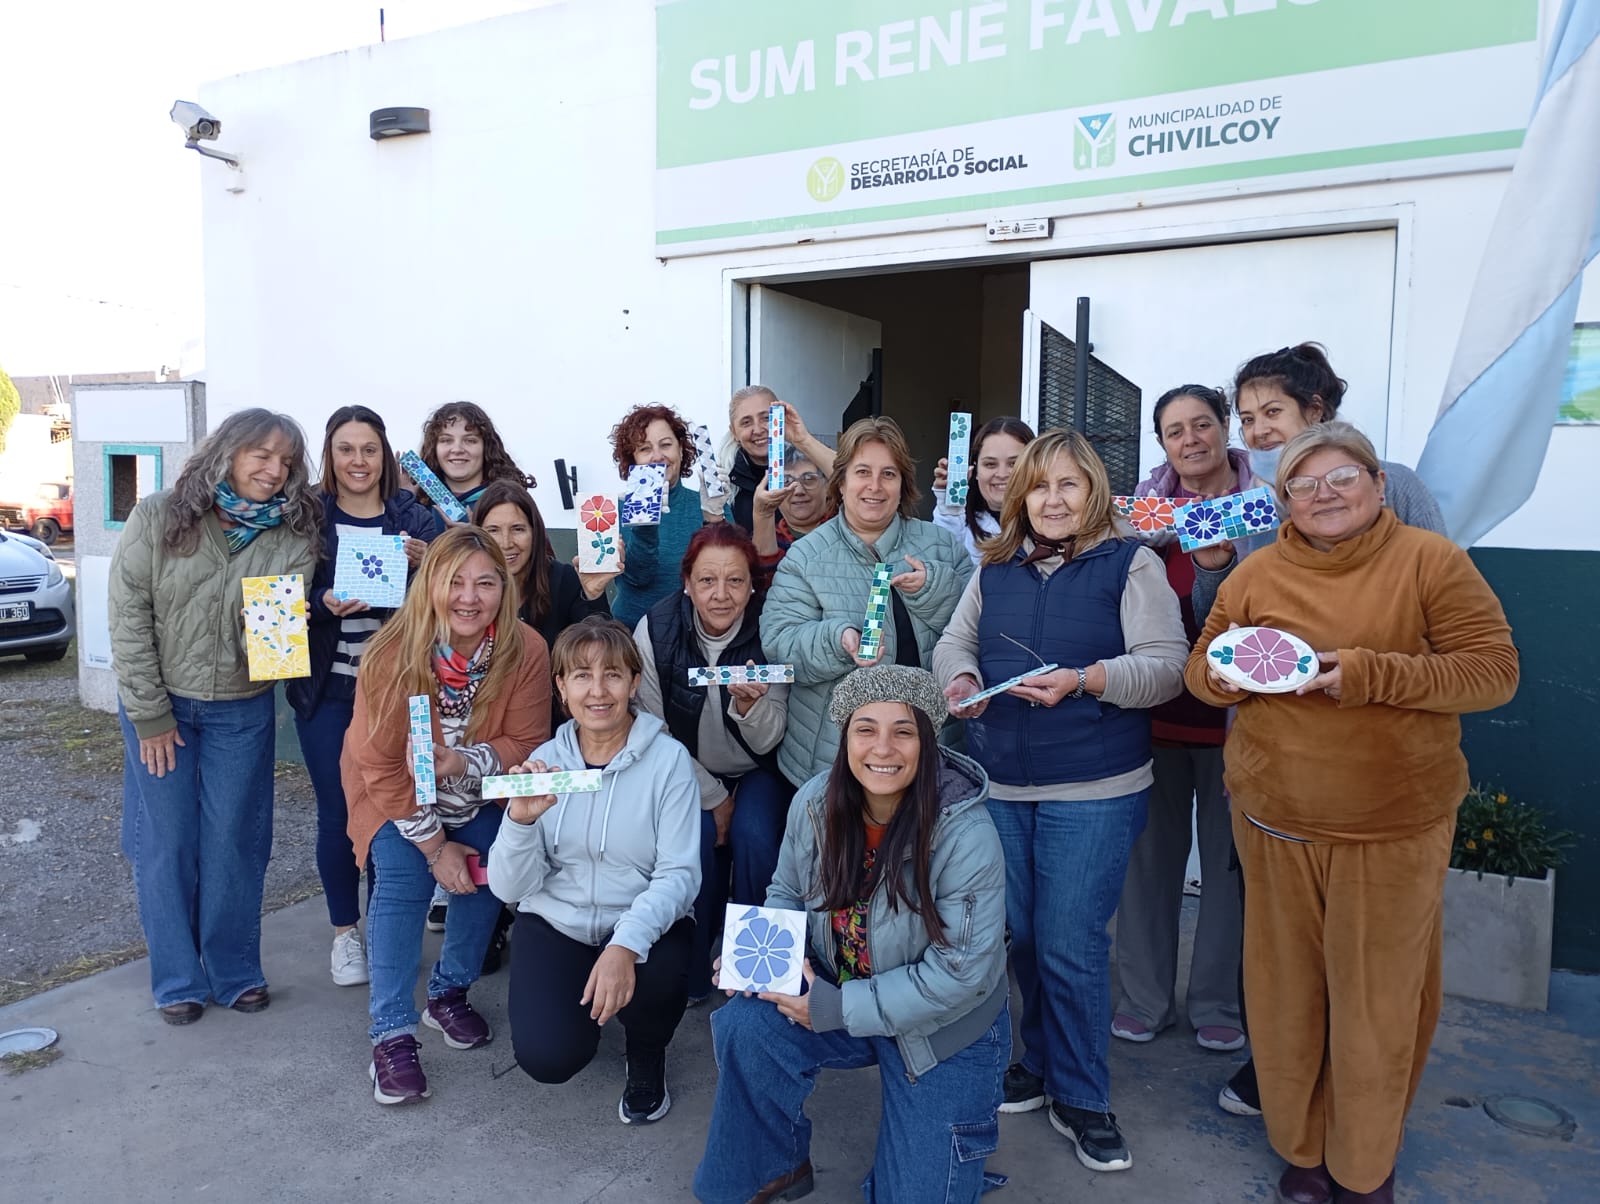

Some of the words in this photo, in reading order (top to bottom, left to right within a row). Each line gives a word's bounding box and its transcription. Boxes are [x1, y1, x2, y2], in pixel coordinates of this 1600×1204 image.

[689, 40, 815, 110] SUM
[1029, 0, 1322, 50] FAV
[1128, 100, 1255, 129] MUNICIPALIDAD
[1260, 96, 1282, 111] DE
[1128, 116, 1281, 157] CHIVILCOY
[851, 149, 947, 176] SECRETARÍA
[953, 147, 974, 162] DE
[851, 164, 959, 190] DESARROLLO
[964, 154, 1028, 175] SOCIAL
[11, 607, 28, 618] 360
